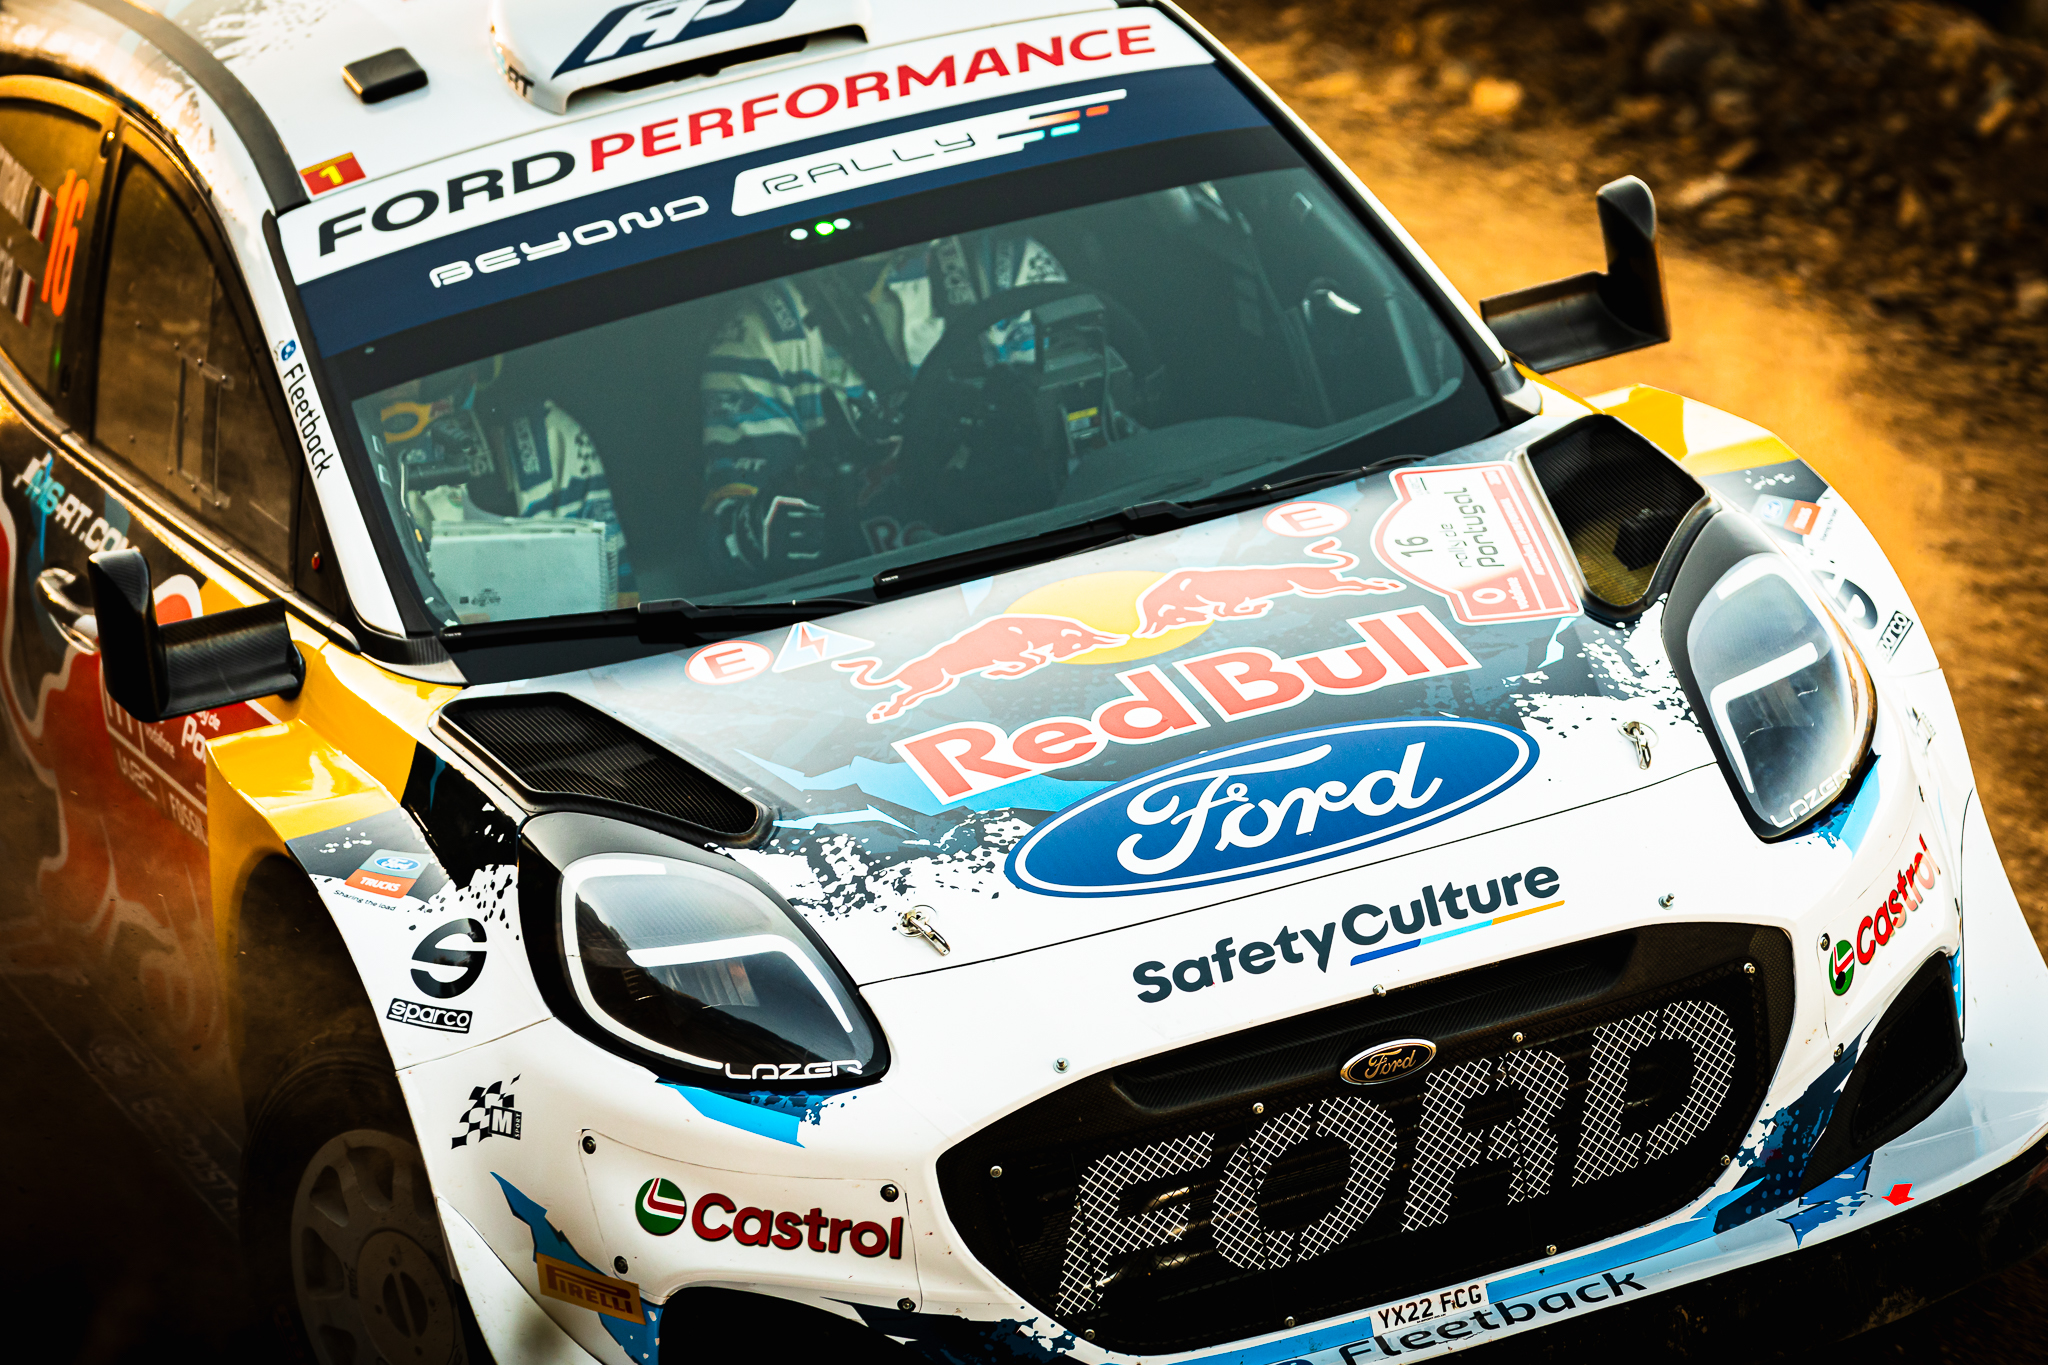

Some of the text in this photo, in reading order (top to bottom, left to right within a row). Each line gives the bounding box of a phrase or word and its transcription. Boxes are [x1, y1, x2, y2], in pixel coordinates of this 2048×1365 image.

[318, 25, 1156, 257] FORD PERFORMANCE
[319, 164, 344, 185] 1
[429, 132, 976, 289] BEYOND RALLY
[41, 169, 89, 317] 16
[284, 363, 334, 478] Fleetback
[1280, 507, 1334, 533] E
[1394, 536, 1433, 557] 16
[1443, 486, 1505, 568] Portugal
[704, 647, 755, 680] E
[905, 611, 1470, 797] Red Bull
[1117, 741, 1443, 875] Ford
[1769, 767, 1852, 828] LAZER
[360, 876, 401, 892] TRUCKS
[381, 857, 413, 870] Ford
[333, 889, 363, 903] Sharing
[379, 902, 397, 911] load
[1856, 833, 1941, 965] Castrol
[1133, 866, 1560, 1003] SafetyCulture
[390, 1000, 471, 1028] sparco
[724, 1059, 863, 1081] LAZER
[1365, 1047, 1418, 1080] Ford
[1055, 1000, 1738, 1317] FORD
[692, 1192, 904, 1260] Castrol
[544, 1263, 634, 1316] PIRELLI
[1338, 1271, 1648, 1365] Fleetback
[1377, 1300, 1434, 1329] YX22
[1440, 1284, 1483, 1311] FCG
